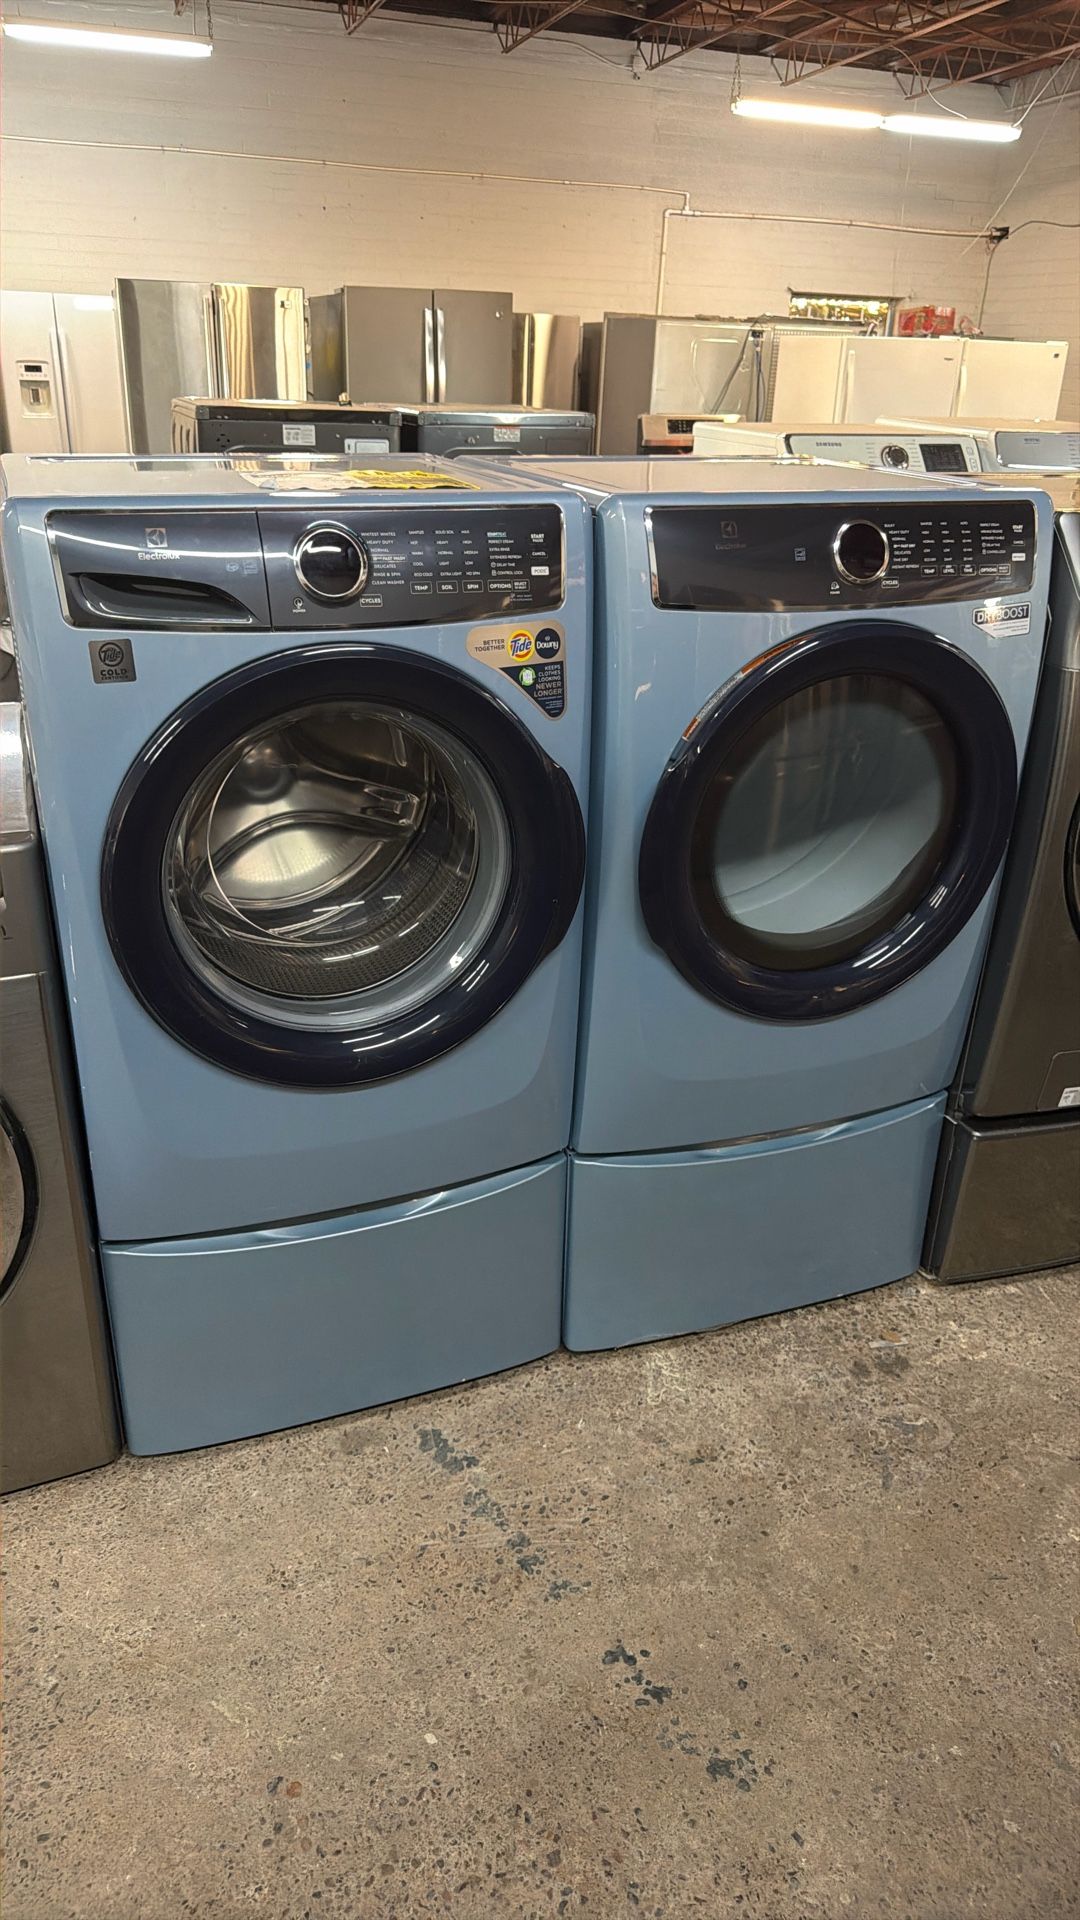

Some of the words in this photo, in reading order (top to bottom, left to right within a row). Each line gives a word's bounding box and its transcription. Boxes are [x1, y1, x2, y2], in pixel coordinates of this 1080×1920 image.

[511, 637, 532, 656] Tide
[536, 640, 559, 650] Downy
[100, 668, 128, 676] COLD
[535, 681, 562, 690] NEWER
[534, 689, 562, 697] LONGER
